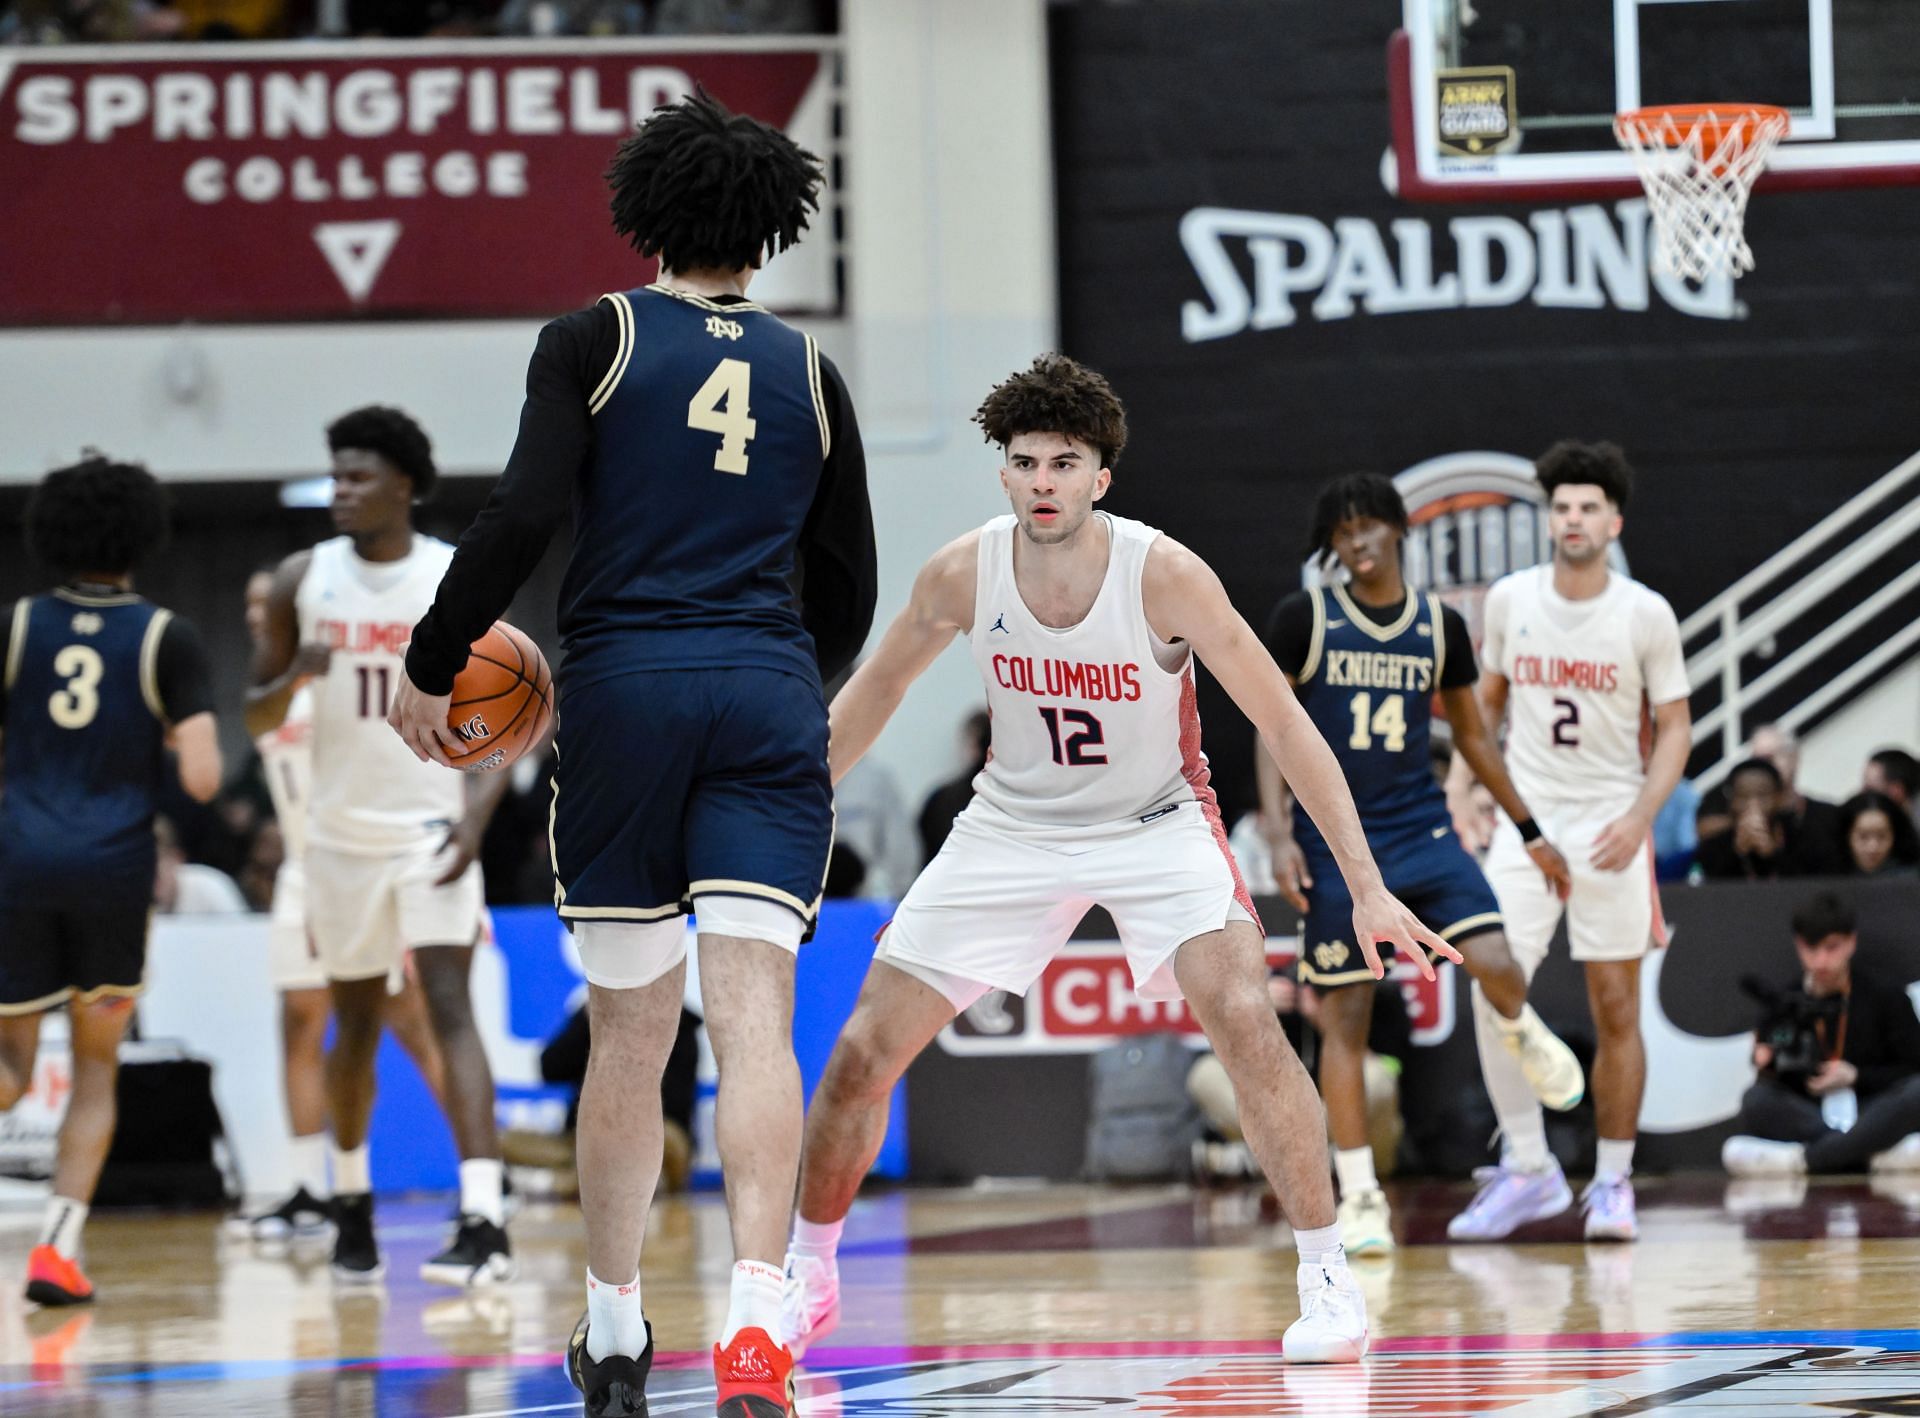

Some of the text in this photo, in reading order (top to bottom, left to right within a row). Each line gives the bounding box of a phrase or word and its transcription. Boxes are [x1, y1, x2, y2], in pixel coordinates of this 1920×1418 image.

[14, 66, 694, 144] SPRINGFIELD
[183, 151, 528, 204] COLLEGE
[687, 357, 757, 476] 4
[48, 643, 104, 730] 3
[356, 665, 390, 719] 11
[992, 653, 1141, 702] COLUMBUS
[1325, 650, 1433, 692] KNIGHTS
[1513, 655, 1619, 694] COLUMBUS
[1038, 706, 1109, 766] 12
[1348, 692, 1407, 753] 14
[1551, 698, 1580, 748] 2
